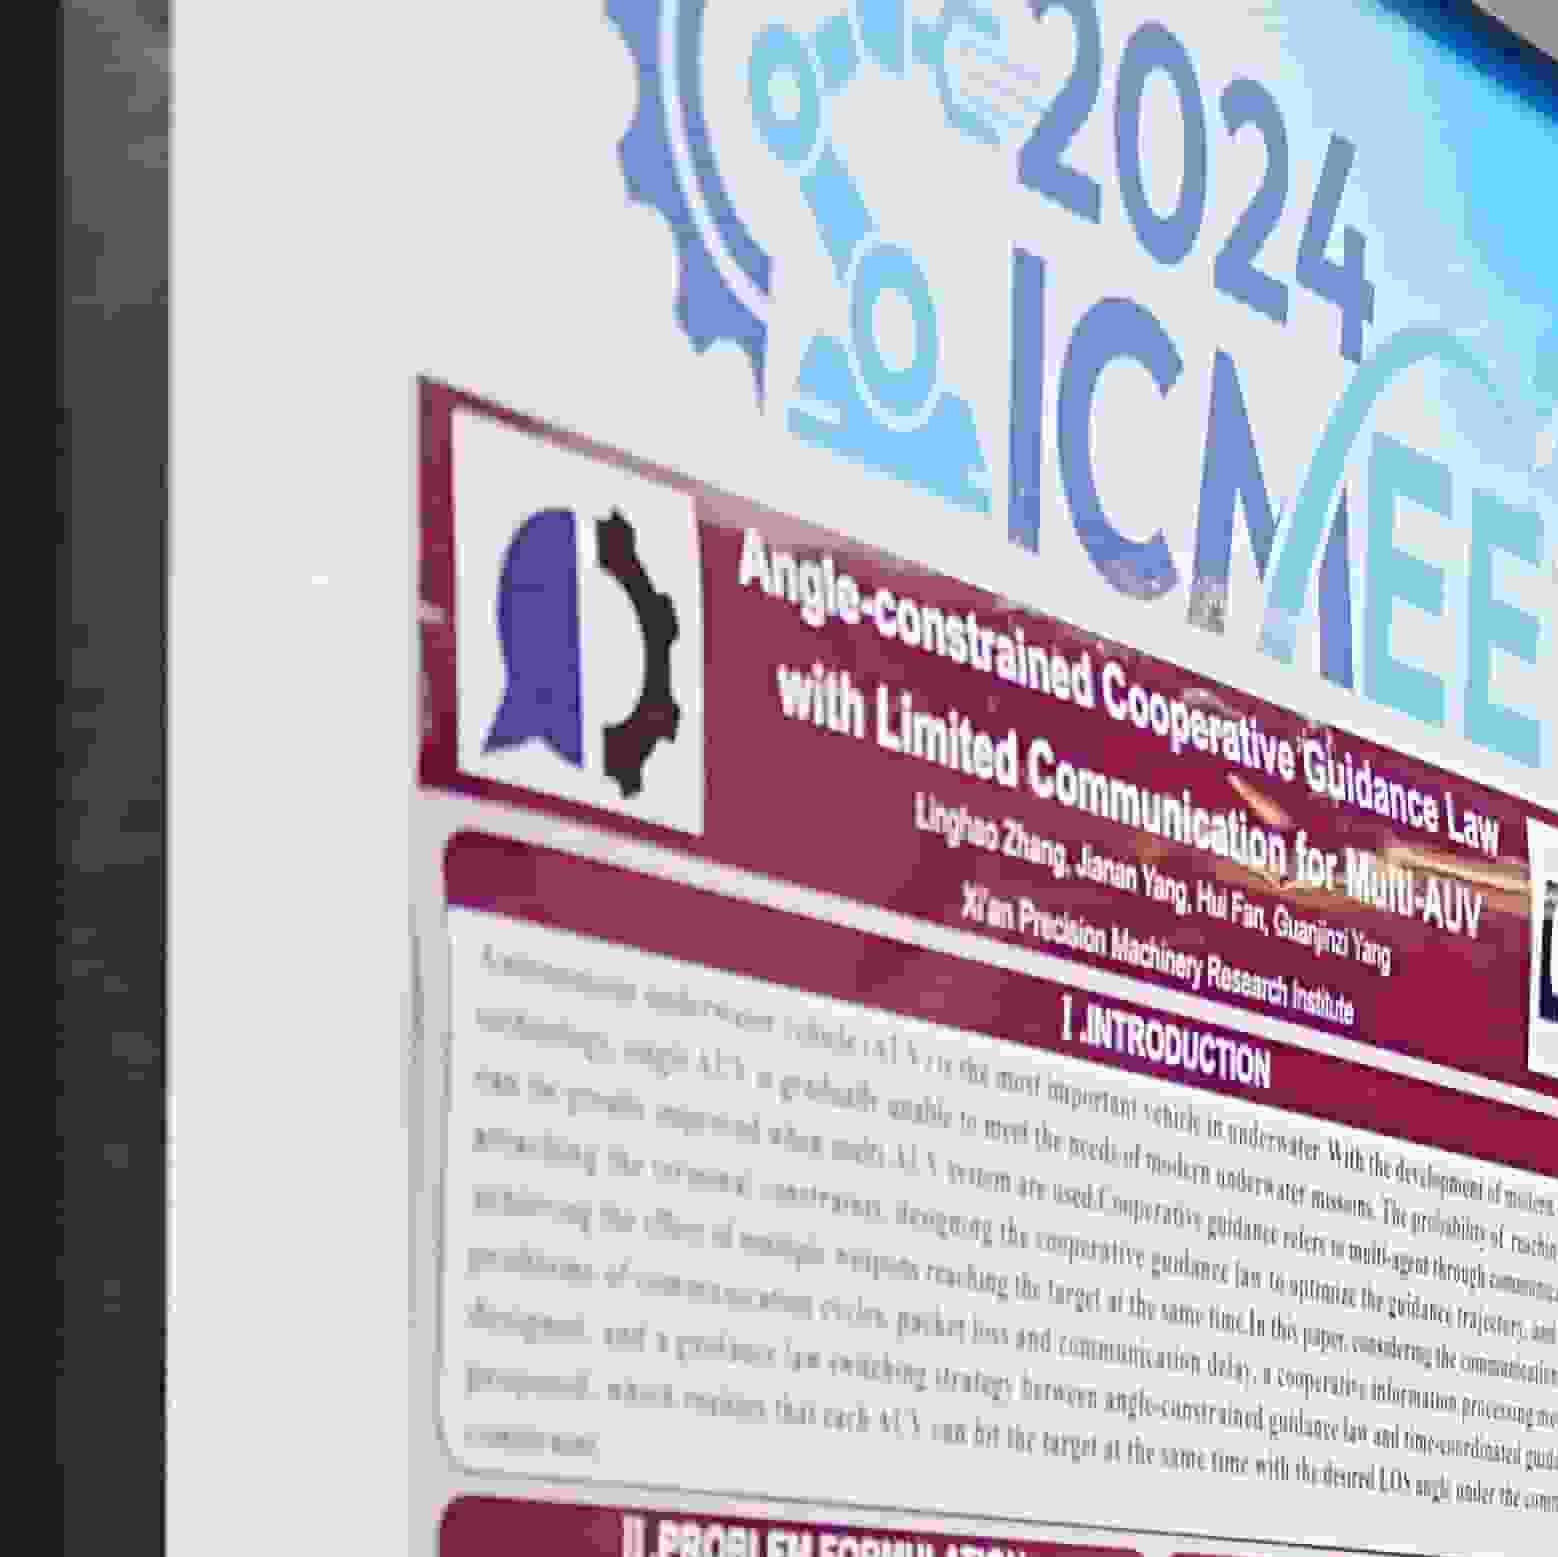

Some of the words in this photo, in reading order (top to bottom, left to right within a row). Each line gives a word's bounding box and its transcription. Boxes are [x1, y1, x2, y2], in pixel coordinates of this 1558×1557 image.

[1015, 0, 1375, 361] 2024
[1007, 248, 1545, 769] ICMEE
[741, 543, 1094, 707] Angle-constrained
[1101, 663, 1296, 780] Cooperative
[1299, 739, 1440, 833] Guidance
[1444, 800, 1500, 858] Law
[777, 664, 866, 738] with
[875, 690, 1020, 787] Limited
[1027, 749, 1287, 874] Communication
[1293, 832, 1337, 891] for
[1344, 849, 1483, 935] Multi-AUV
[912, 793, 1001, 852] Linghao
[1000, 818, 1072, 879] Zhang,
[1073, 848, 1140, 893] Jianan
[1140, 862, 1193, 916] Yang,
[1194, 879, 1230, 921] Hui
[1228, 889, 1270, 936] Fan,
[1271, 905, 1350, 957] Guanjinzi
[1349, 929, 1393, 978] Yang
[960, 882, 1016, 931] Xi'an
[1016, 899, 1108, 956] Precision
[1108, 927, 1204, 982] Machinery
[1205, 955, 1290, 1007] Research
[1289, 982, 1356, 1026] Institute
